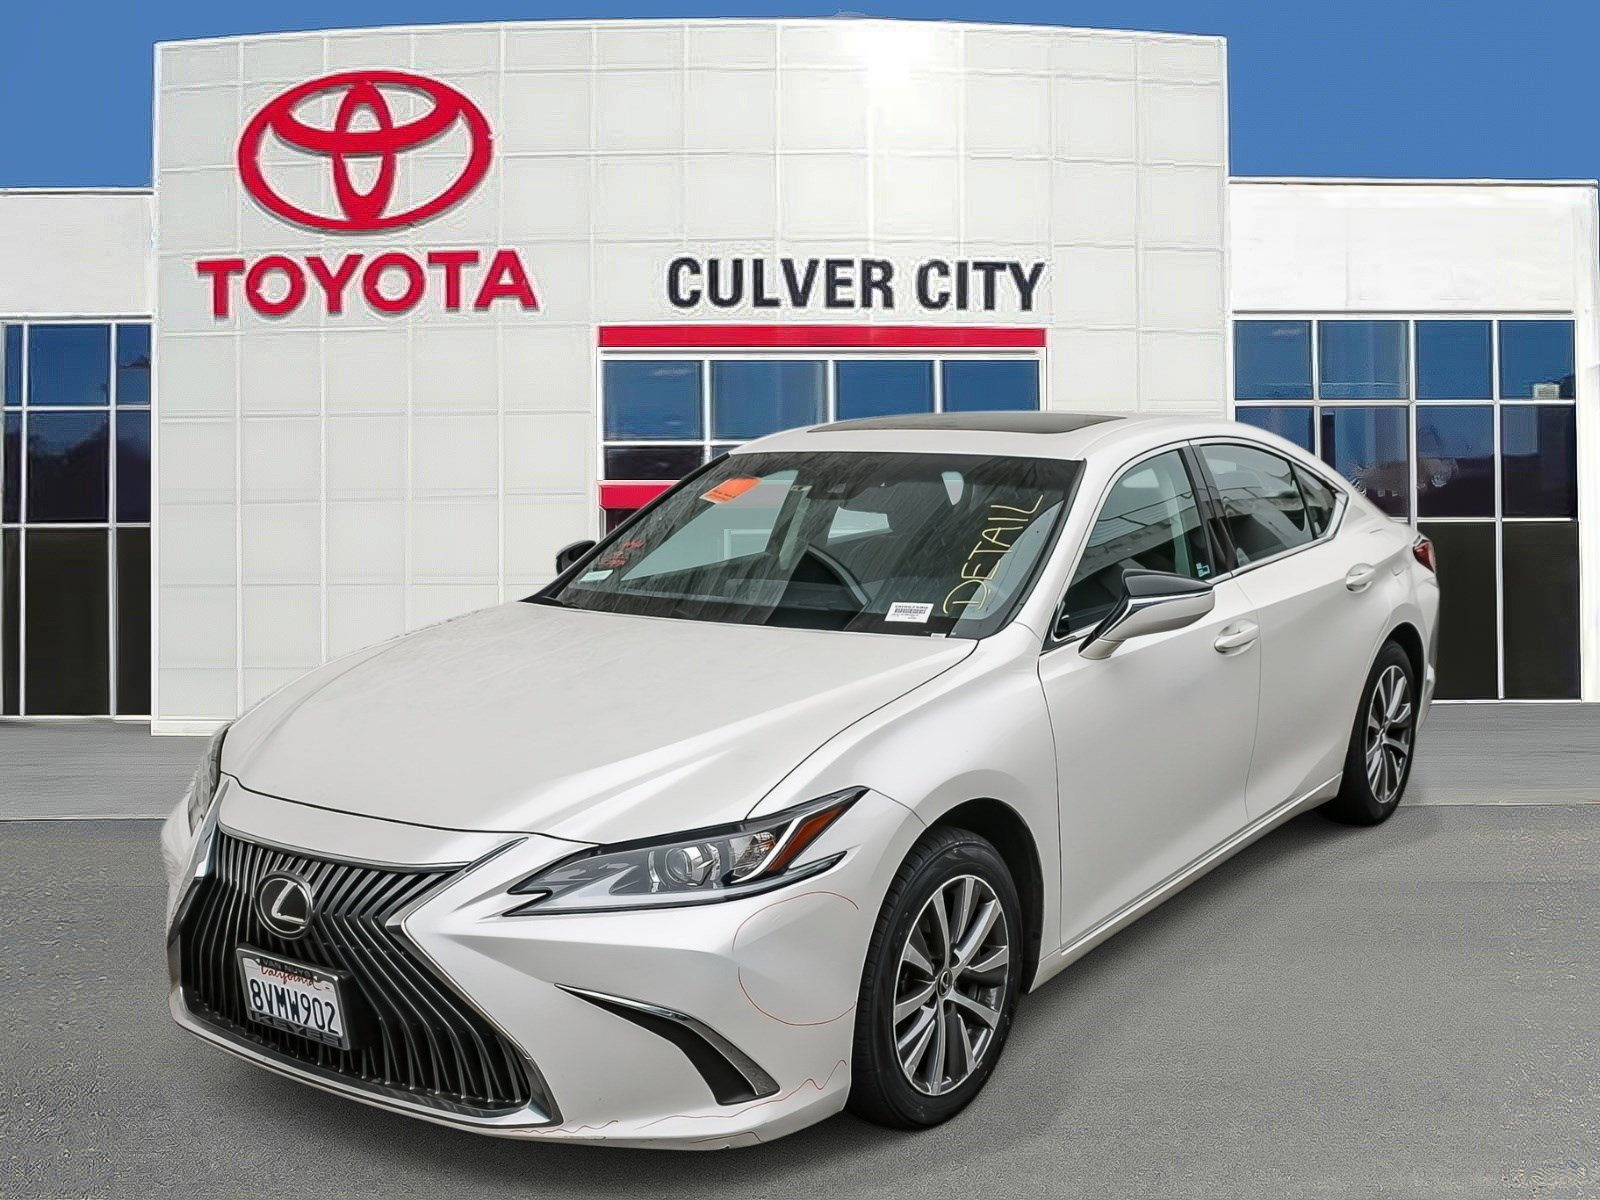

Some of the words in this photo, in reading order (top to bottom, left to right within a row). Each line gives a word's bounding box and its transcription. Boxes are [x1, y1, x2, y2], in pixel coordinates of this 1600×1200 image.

[197, 250, 539, 317] TOYOTA
[667, 257, 896, 308] CULVER
[916, 260, 1045, 311] CITY
[943, 494, 1044, 614] DETAIL
[250, 978, 340, 1035] 8VMW902
